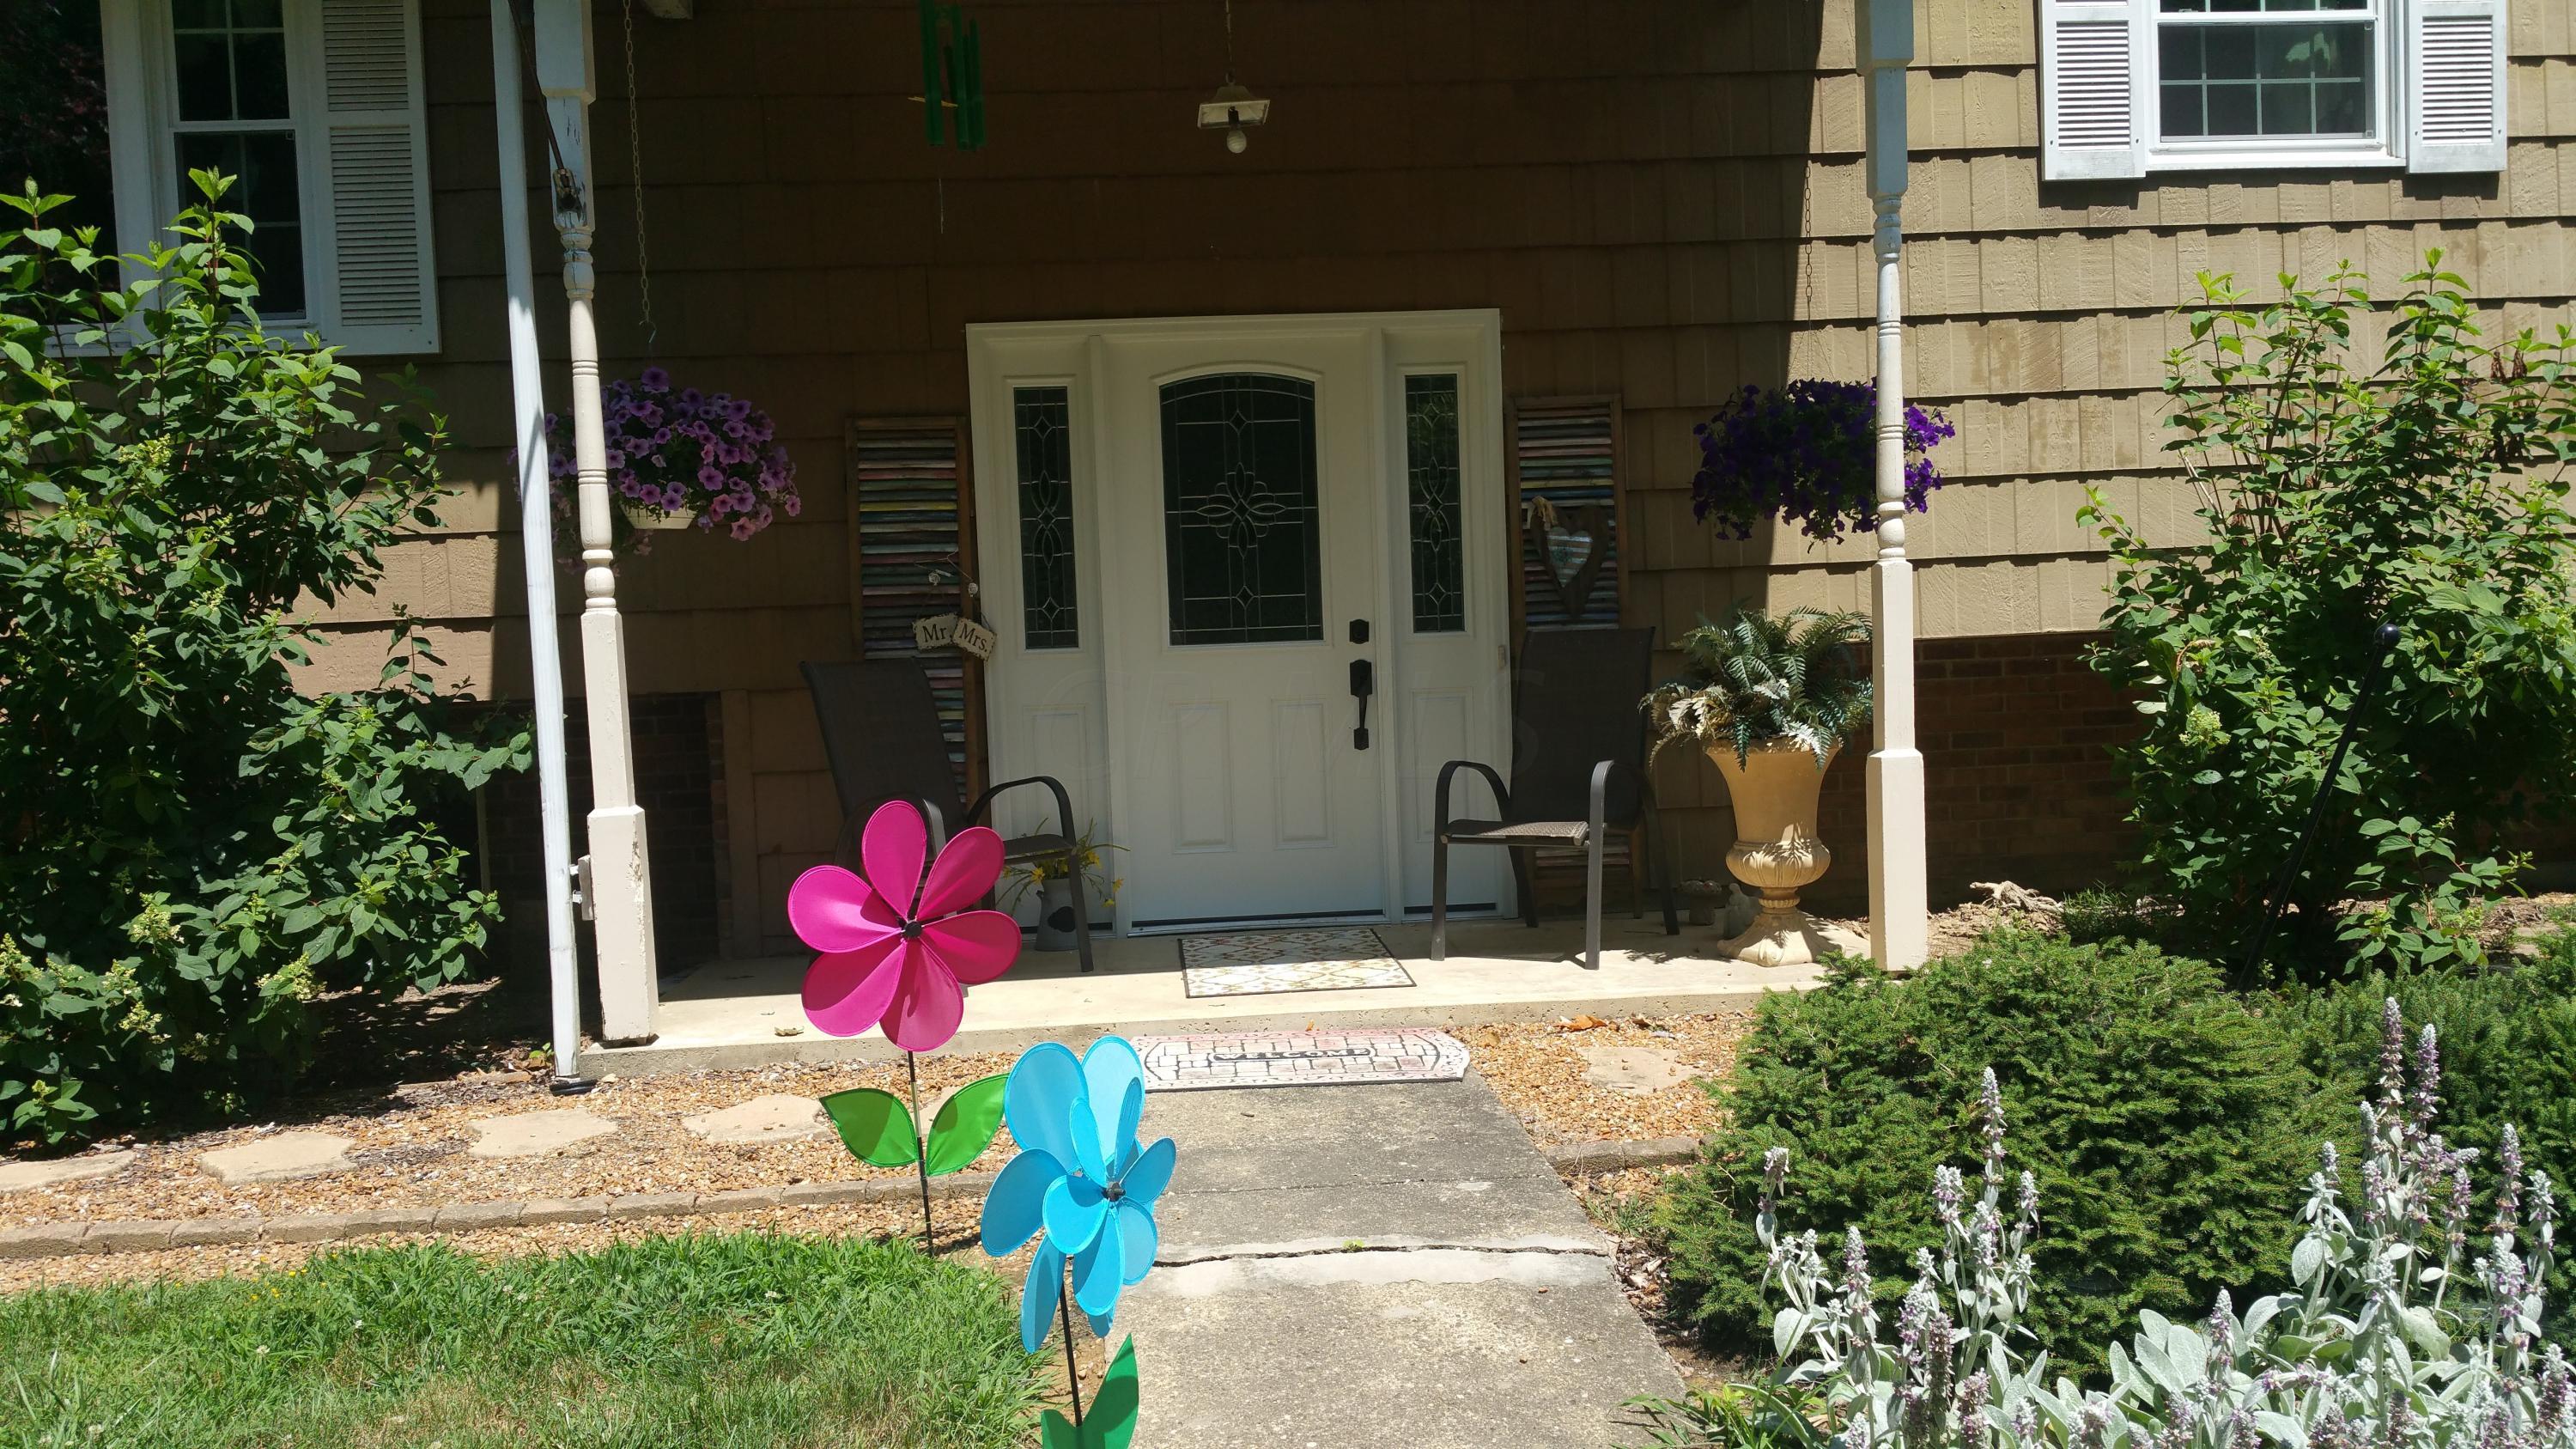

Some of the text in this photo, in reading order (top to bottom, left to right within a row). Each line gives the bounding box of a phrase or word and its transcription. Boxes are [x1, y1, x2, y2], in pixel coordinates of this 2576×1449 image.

[922, 624, 953, 643] Mr.
[959, 623, 988, 652] Mrs.
[1215, 1048, 1369, 1061] WELCOME
